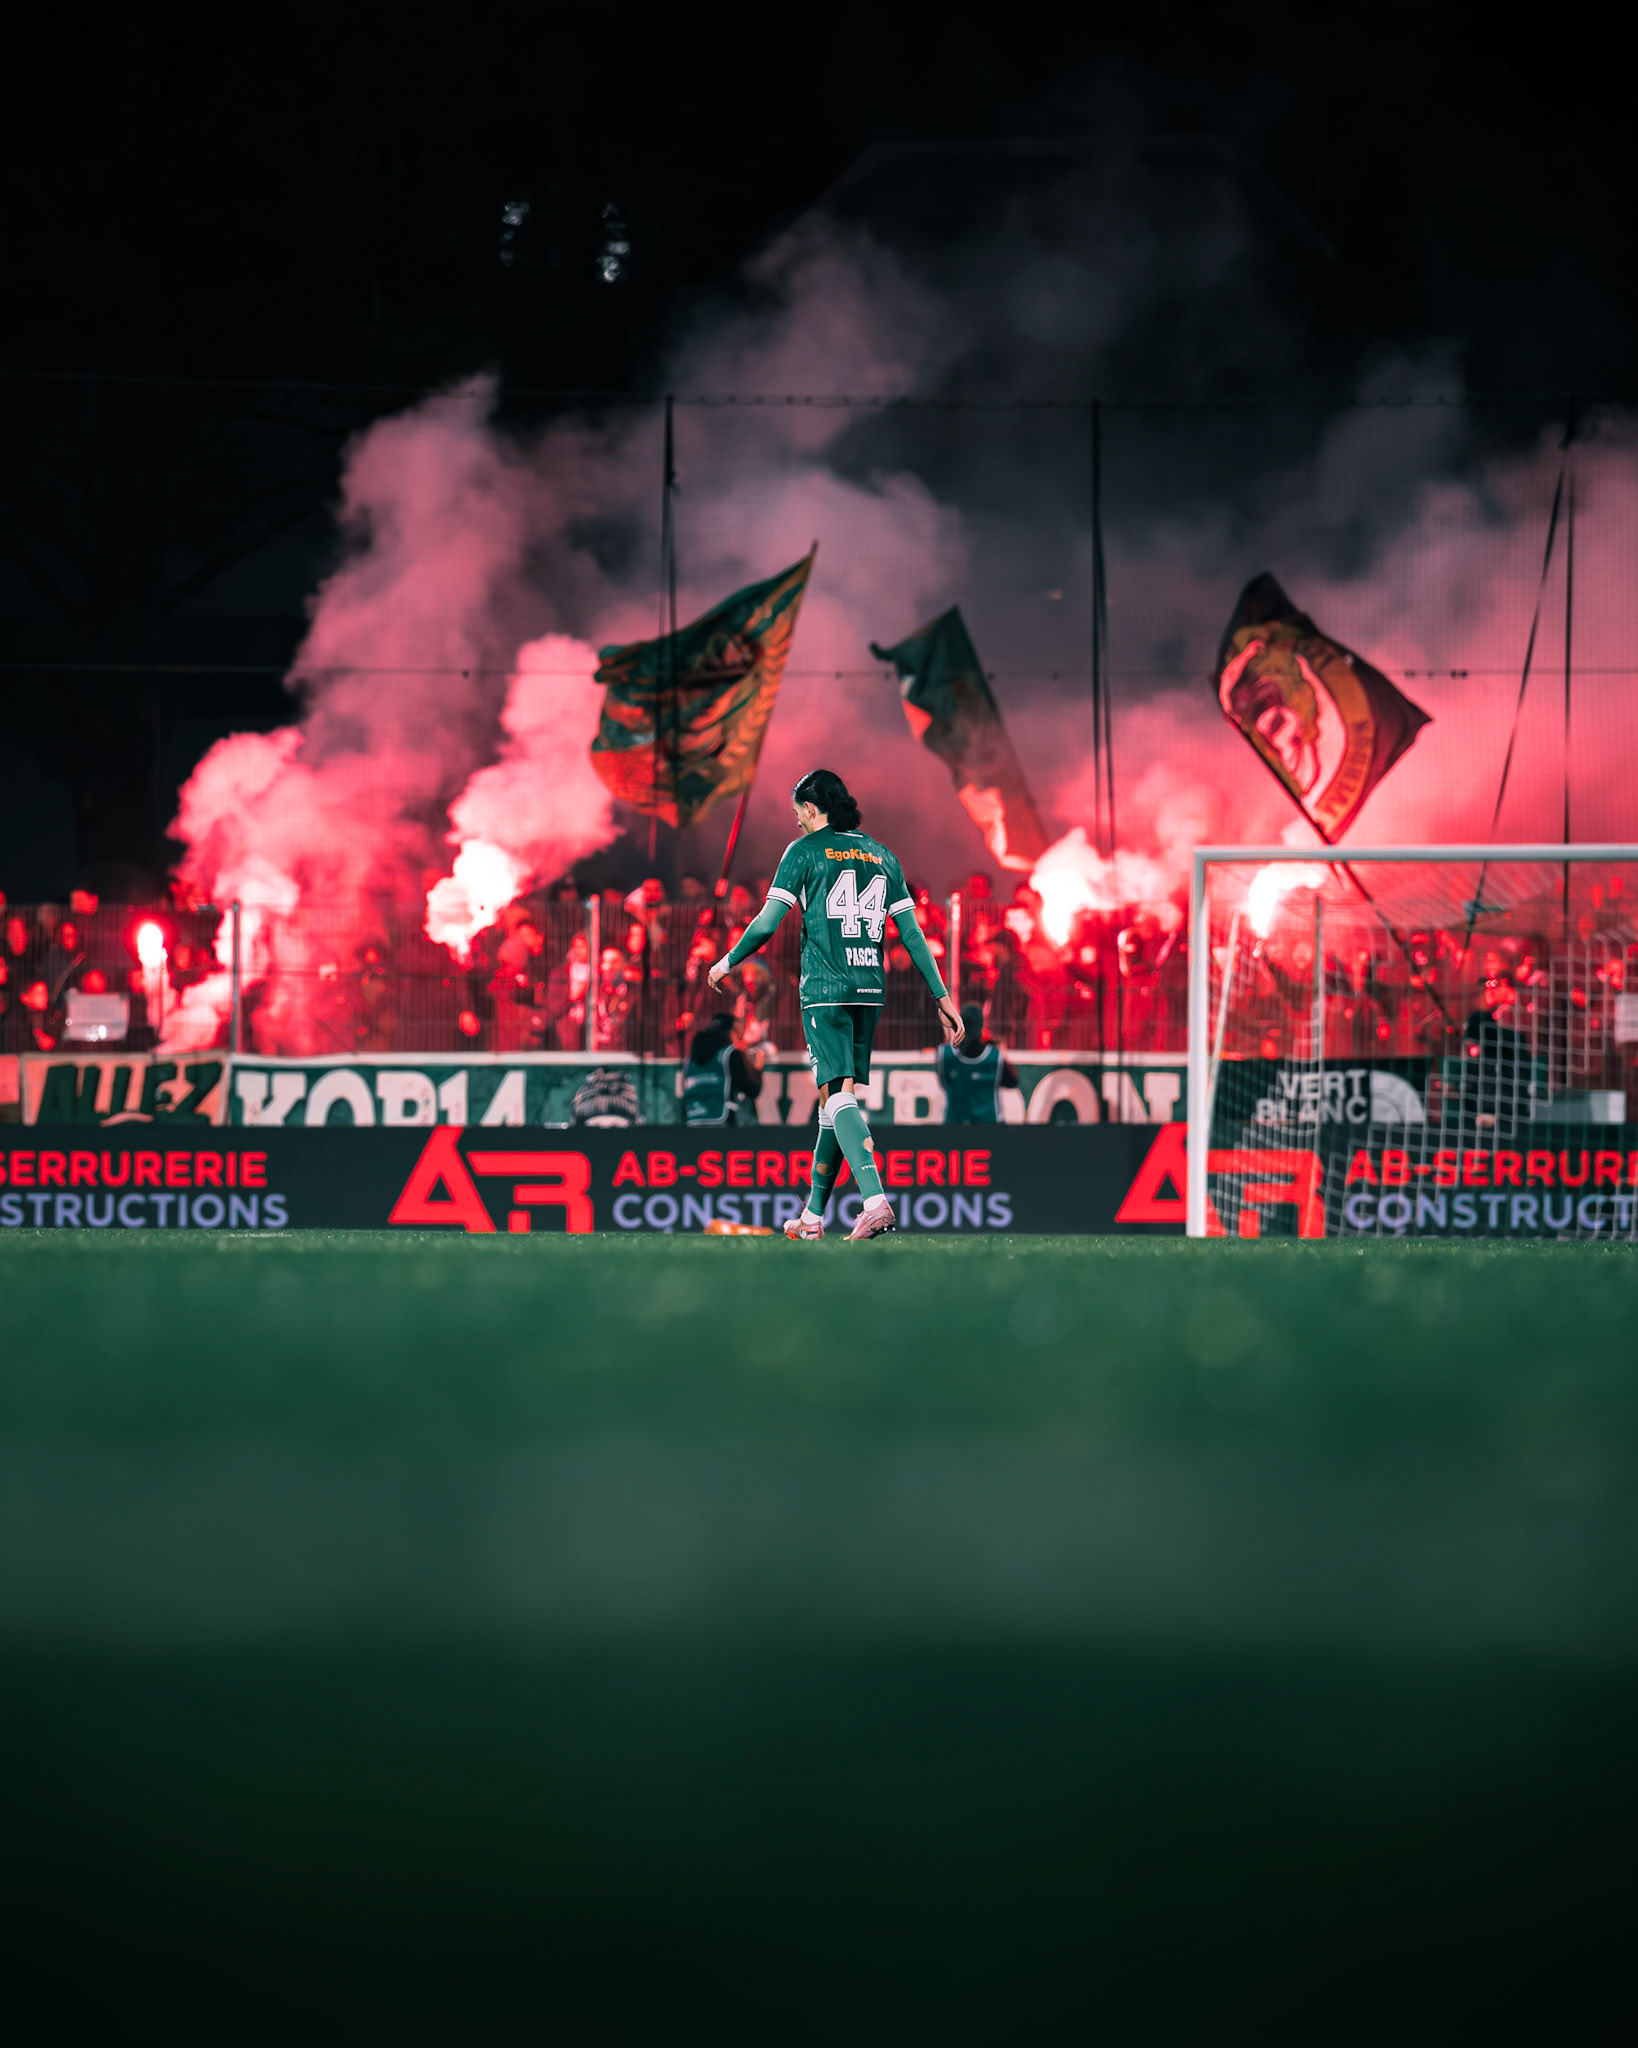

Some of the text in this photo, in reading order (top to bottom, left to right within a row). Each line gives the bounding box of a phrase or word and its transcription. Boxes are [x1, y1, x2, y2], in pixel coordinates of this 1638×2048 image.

[825, 848, 883, 864] EgoKiefer
[826, 869, 887, 942] 44
[1274, 1069, 1369, 1099] VERT
